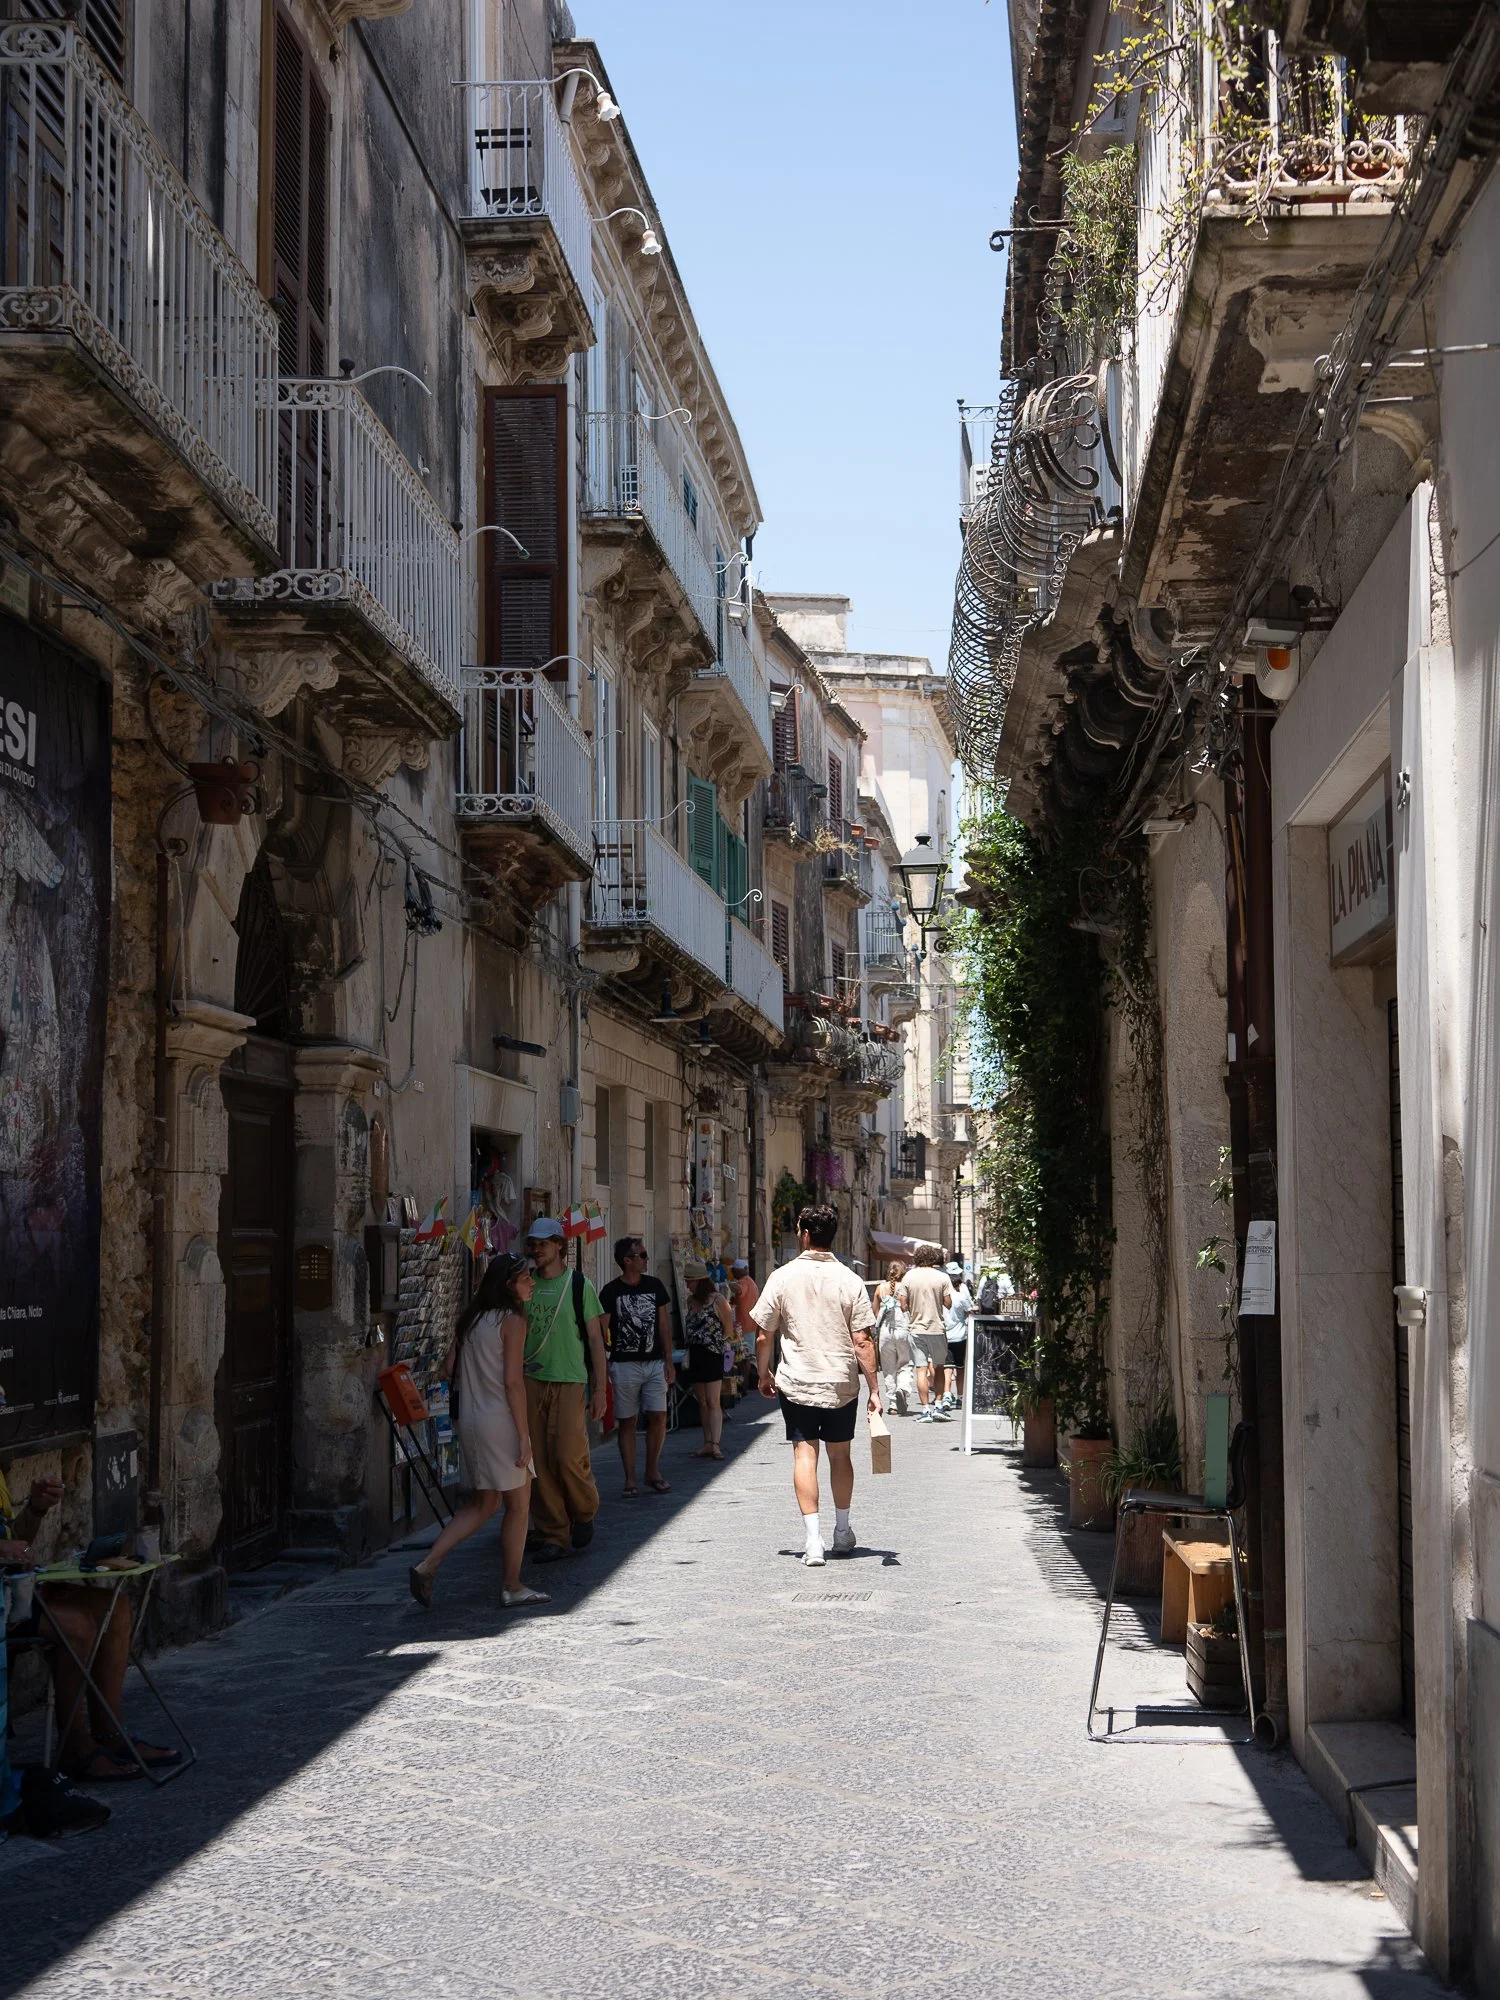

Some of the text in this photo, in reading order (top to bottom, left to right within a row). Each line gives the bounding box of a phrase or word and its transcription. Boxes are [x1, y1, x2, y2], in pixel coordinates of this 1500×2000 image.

[0, 696, 36, 767] SI
[5, 762, 12, 778] DI
[13, 766, 35, 788] OVIDIO
[1332, 820, 1386, 926] LA PIANA
[28, 1305, 42, 1318] Noto
